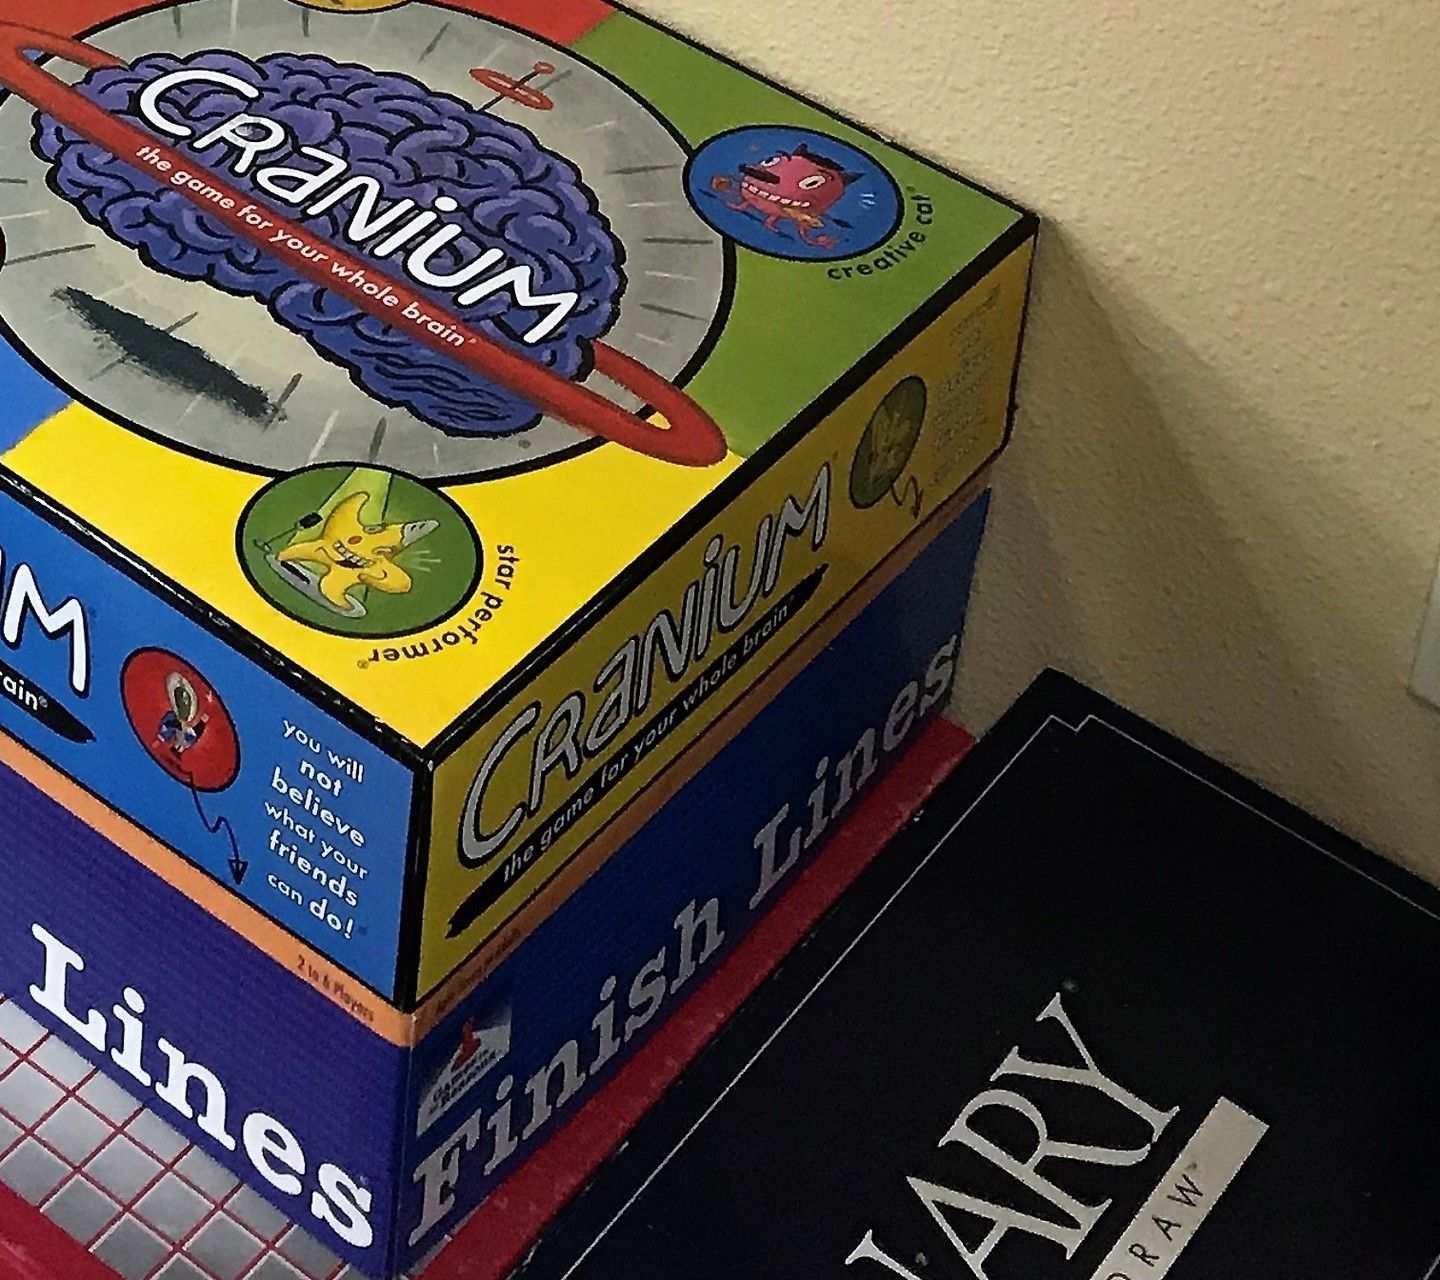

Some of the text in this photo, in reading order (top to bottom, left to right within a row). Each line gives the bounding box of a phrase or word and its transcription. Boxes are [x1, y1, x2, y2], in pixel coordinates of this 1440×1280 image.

[135, 145, 399, 307] the game for your whole
[827, 231, 926, 280] creative
[495, 544, 521, 591] star
[283, 720, 364, 784] you will
[299, 759, 343, 798] not
[502, 843, 535, 884] the
[539, 785, 595, 853] game
[599, 757, 629, 793] for
[632, 708, 678, 764] your
[683, 653, 738, 714] whole
[264, 801, 369, 881] what your
[271, 765, 366, 848] believe
[267, 872, 355, 941] can do!
[268, 829, 358, 908] friends
[410, 633, 960, 1242] Finish Lines
[295, 953, 306, 972] 2
[332, 980, 375, 1023] Players
[29, 922, 375, 1249] Lines
